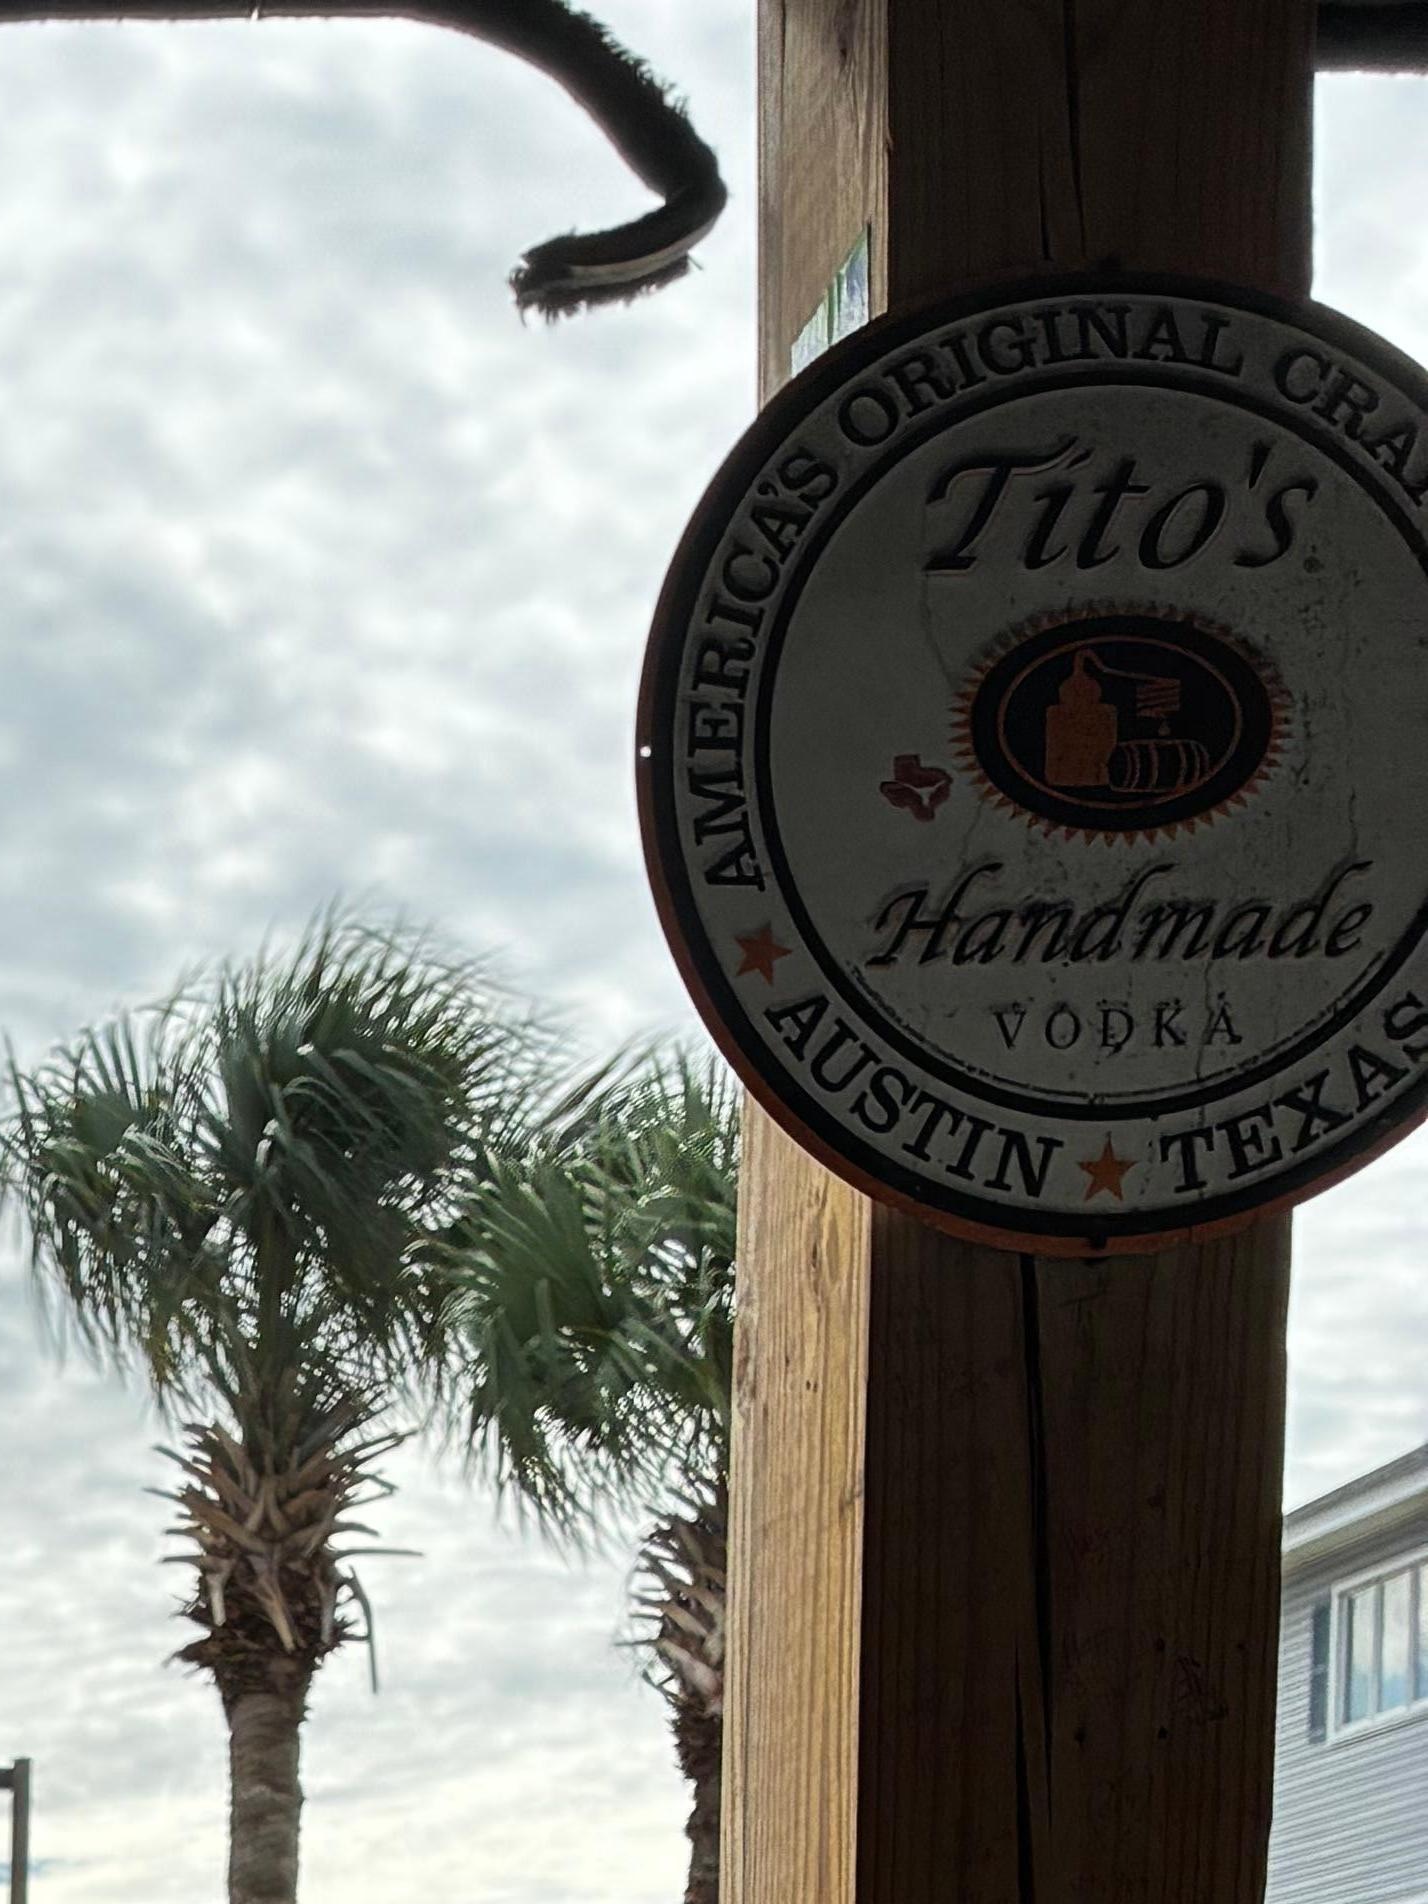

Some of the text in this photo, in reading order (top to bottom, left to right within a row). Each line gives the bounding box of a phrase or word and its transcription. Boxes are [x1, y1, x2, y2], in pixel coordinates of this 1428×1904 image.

[925, 439, 1316, 572] Tito's
[692, 305, 1428, 891] AMERICA'S ORIGINAL CRA
[866, 859, 1376, 970] Handmade
[994, 994, 1242, 1050] VODKA
[767, 992, 1428, 1198] AUSTIN TEXAS
